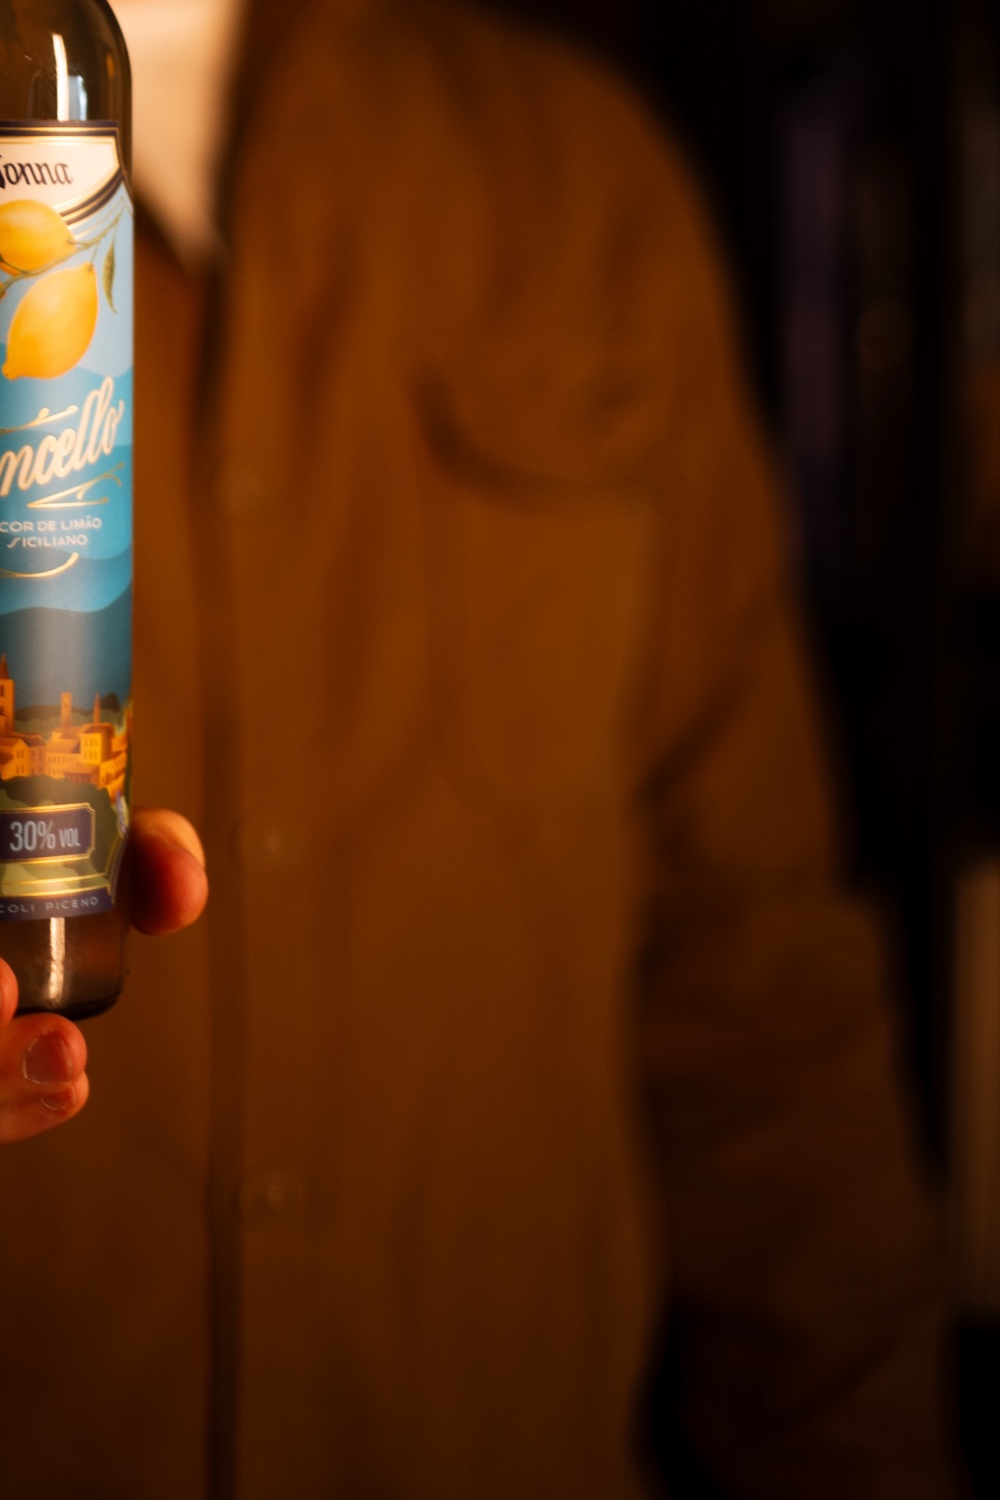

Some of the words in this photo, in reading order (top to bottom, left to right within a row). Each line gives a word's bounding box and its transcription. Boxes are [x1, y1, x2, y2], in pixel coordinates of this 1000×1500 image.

[37, 520, 58, 532] DE
[60, 514, 103, 531] LIMÃO
[6, 533, 89, 549] SICILIANO
[9, 820, 56, 852] 30%
[58, 827, 81, 849] VOL
[45, 896, 100, 911] PICENO
